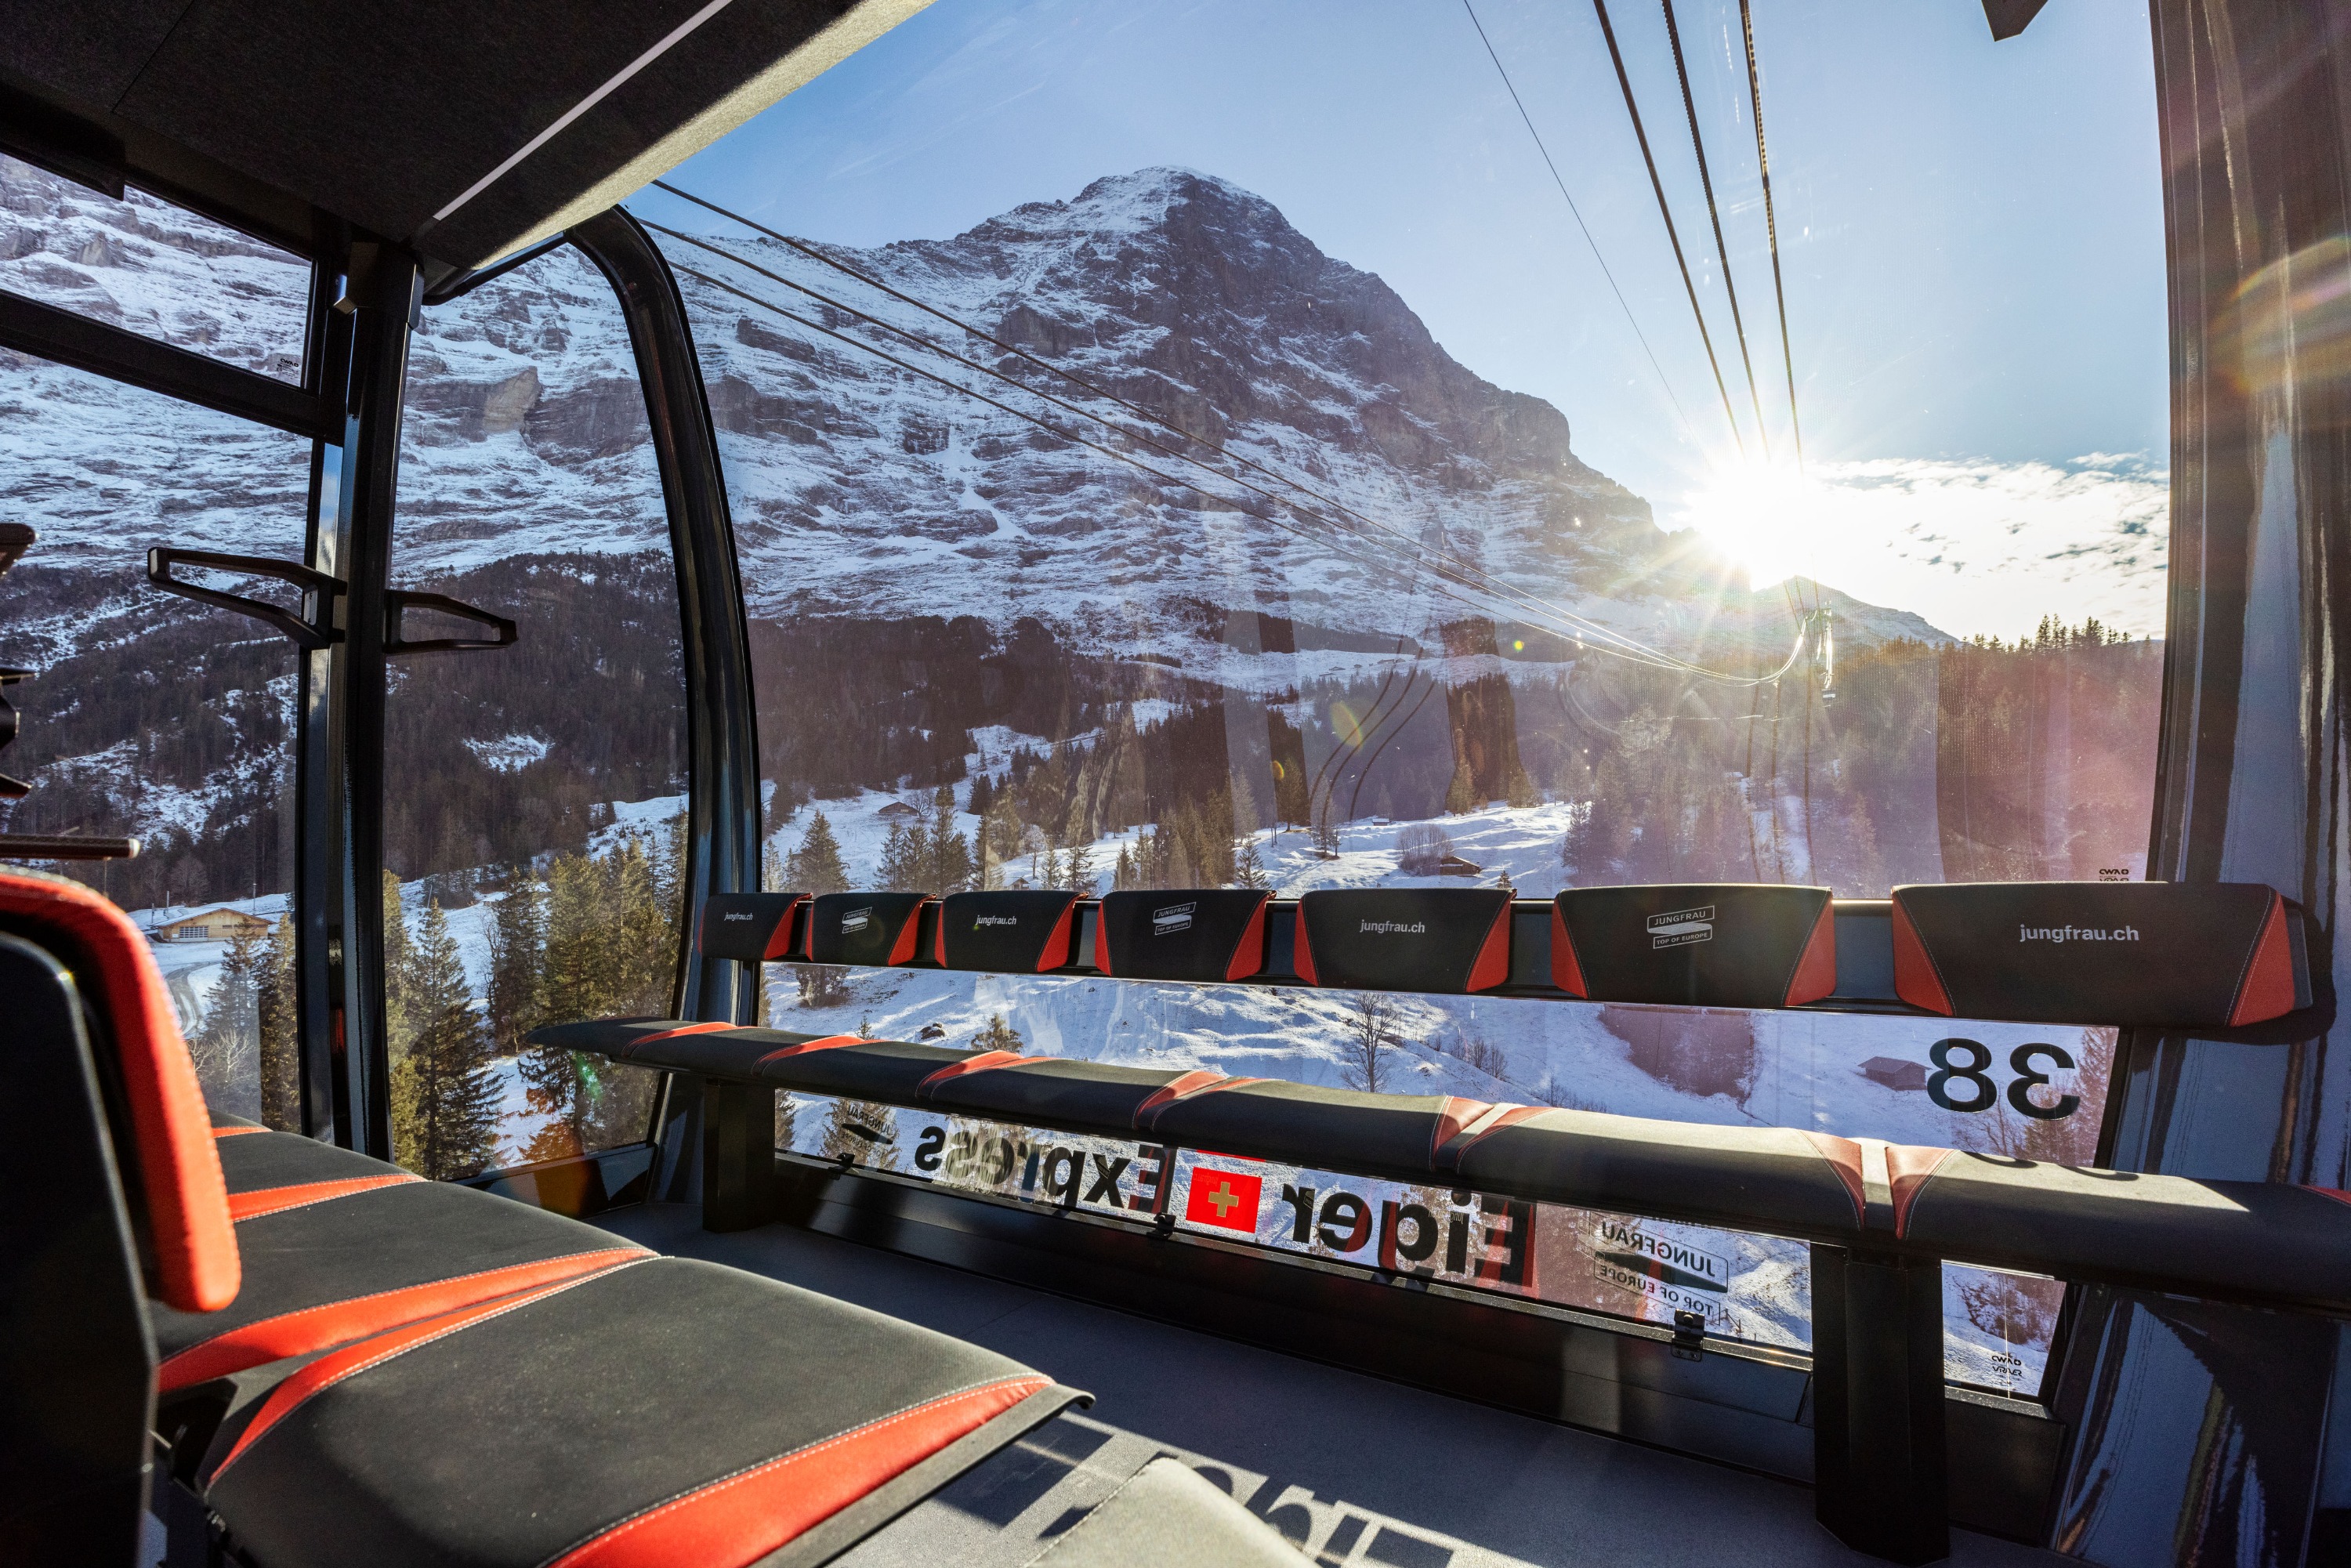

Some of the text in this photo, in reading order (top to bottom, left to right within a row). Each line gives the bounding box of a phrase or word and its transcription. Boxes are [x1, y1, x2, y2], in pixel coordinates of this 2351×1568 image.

[723, 911, 753, 922] jungfrau.ch
[1157, 906, 1190, 917] JUNGFRAU
[975, 914, 1017, 926] jungfrau.ch
[1654, 911, 1706, 925] JUNGFRAU
[1360, 919, 1425, 933] jungfrau.ch
[1682, 932, 1708, 941] EUROPE
[2020, 924, 2139, 943] jungfrau.ch
